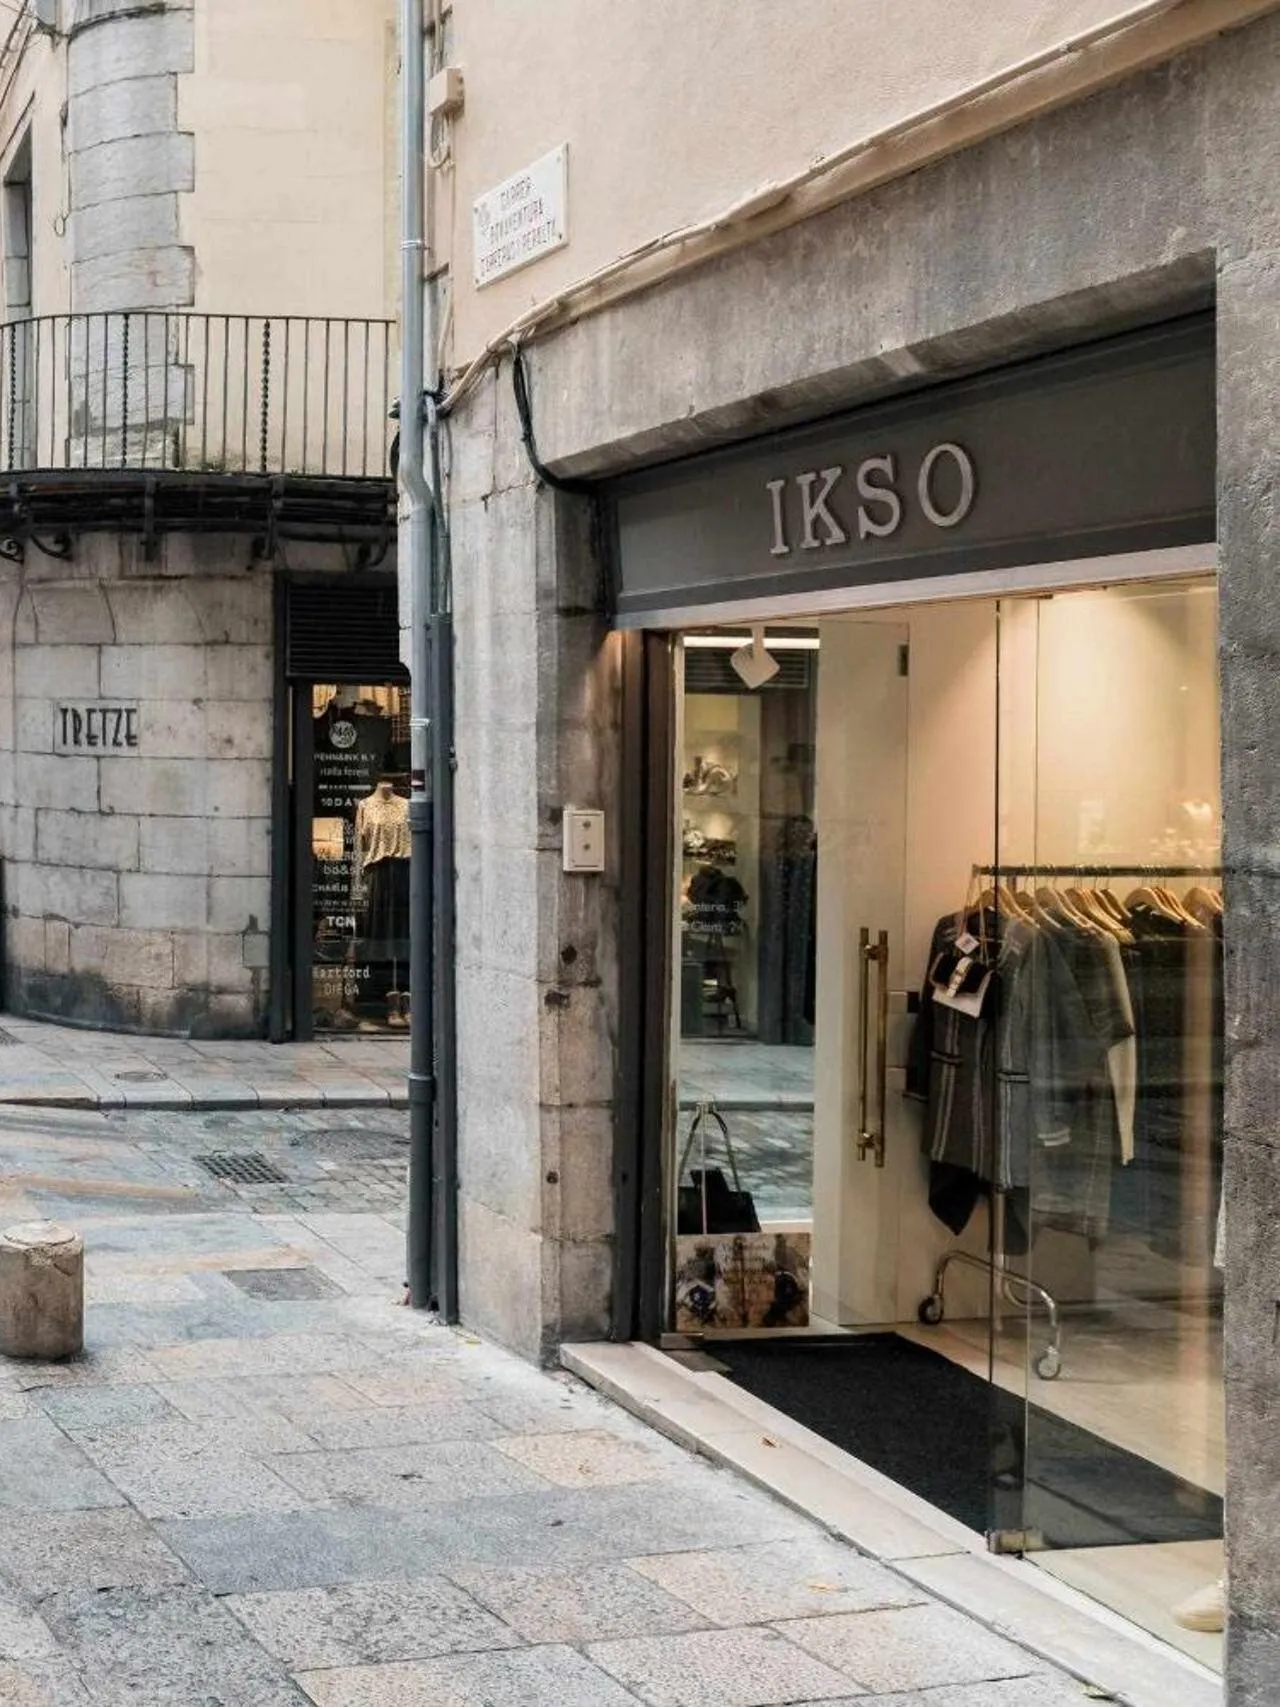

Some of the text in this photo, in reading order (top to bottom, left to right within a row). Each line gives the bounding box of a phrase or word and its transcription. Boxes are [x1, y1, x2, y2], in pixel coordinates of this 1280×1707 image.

[766, 443, 974, 555] IKSO
[60, 707, 138, 747] TRETZE
[326, 915, 356, 927] TCN
